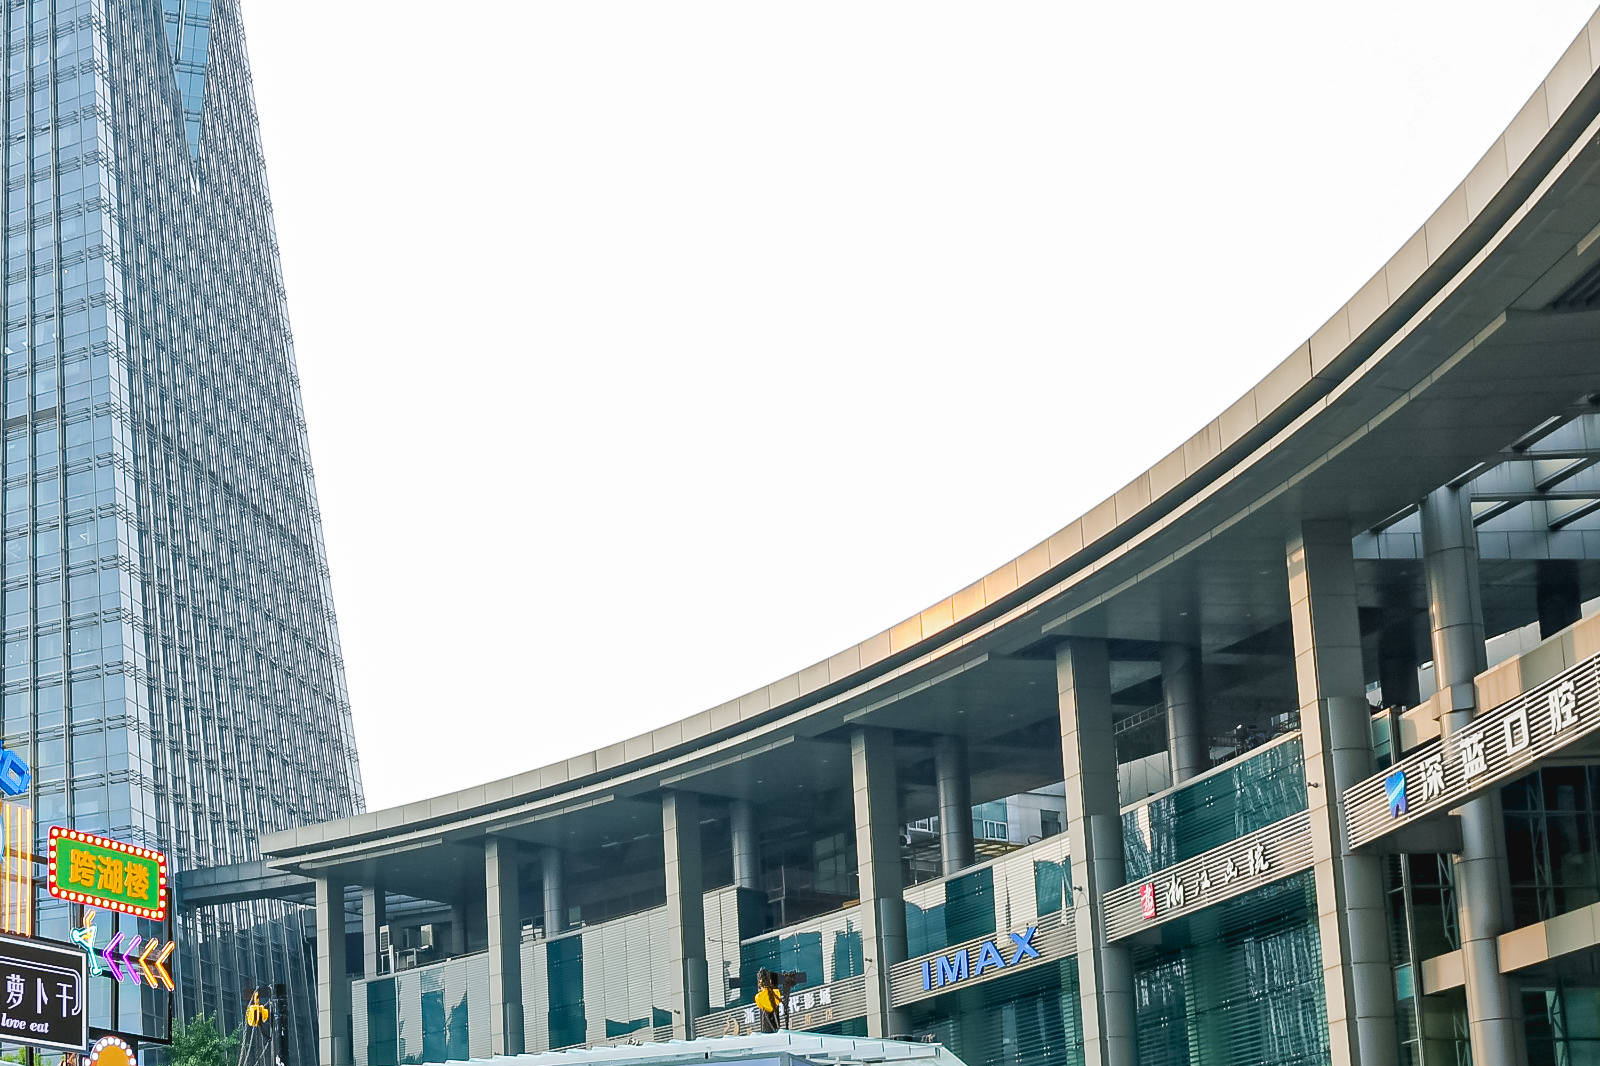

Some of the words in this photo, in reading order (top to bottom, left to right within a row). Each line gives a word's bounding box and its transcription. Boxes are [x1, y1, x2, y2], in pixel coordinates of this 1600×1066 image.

[1419, 679, 1579, 803] 深蓝口腔
[68, 848, 150, 901] 跨湖楼
[921, 926, 1040, 992] IMAX
[1, 1012, 27, 1030] love
[30, 1020, 49, 1034] eat
